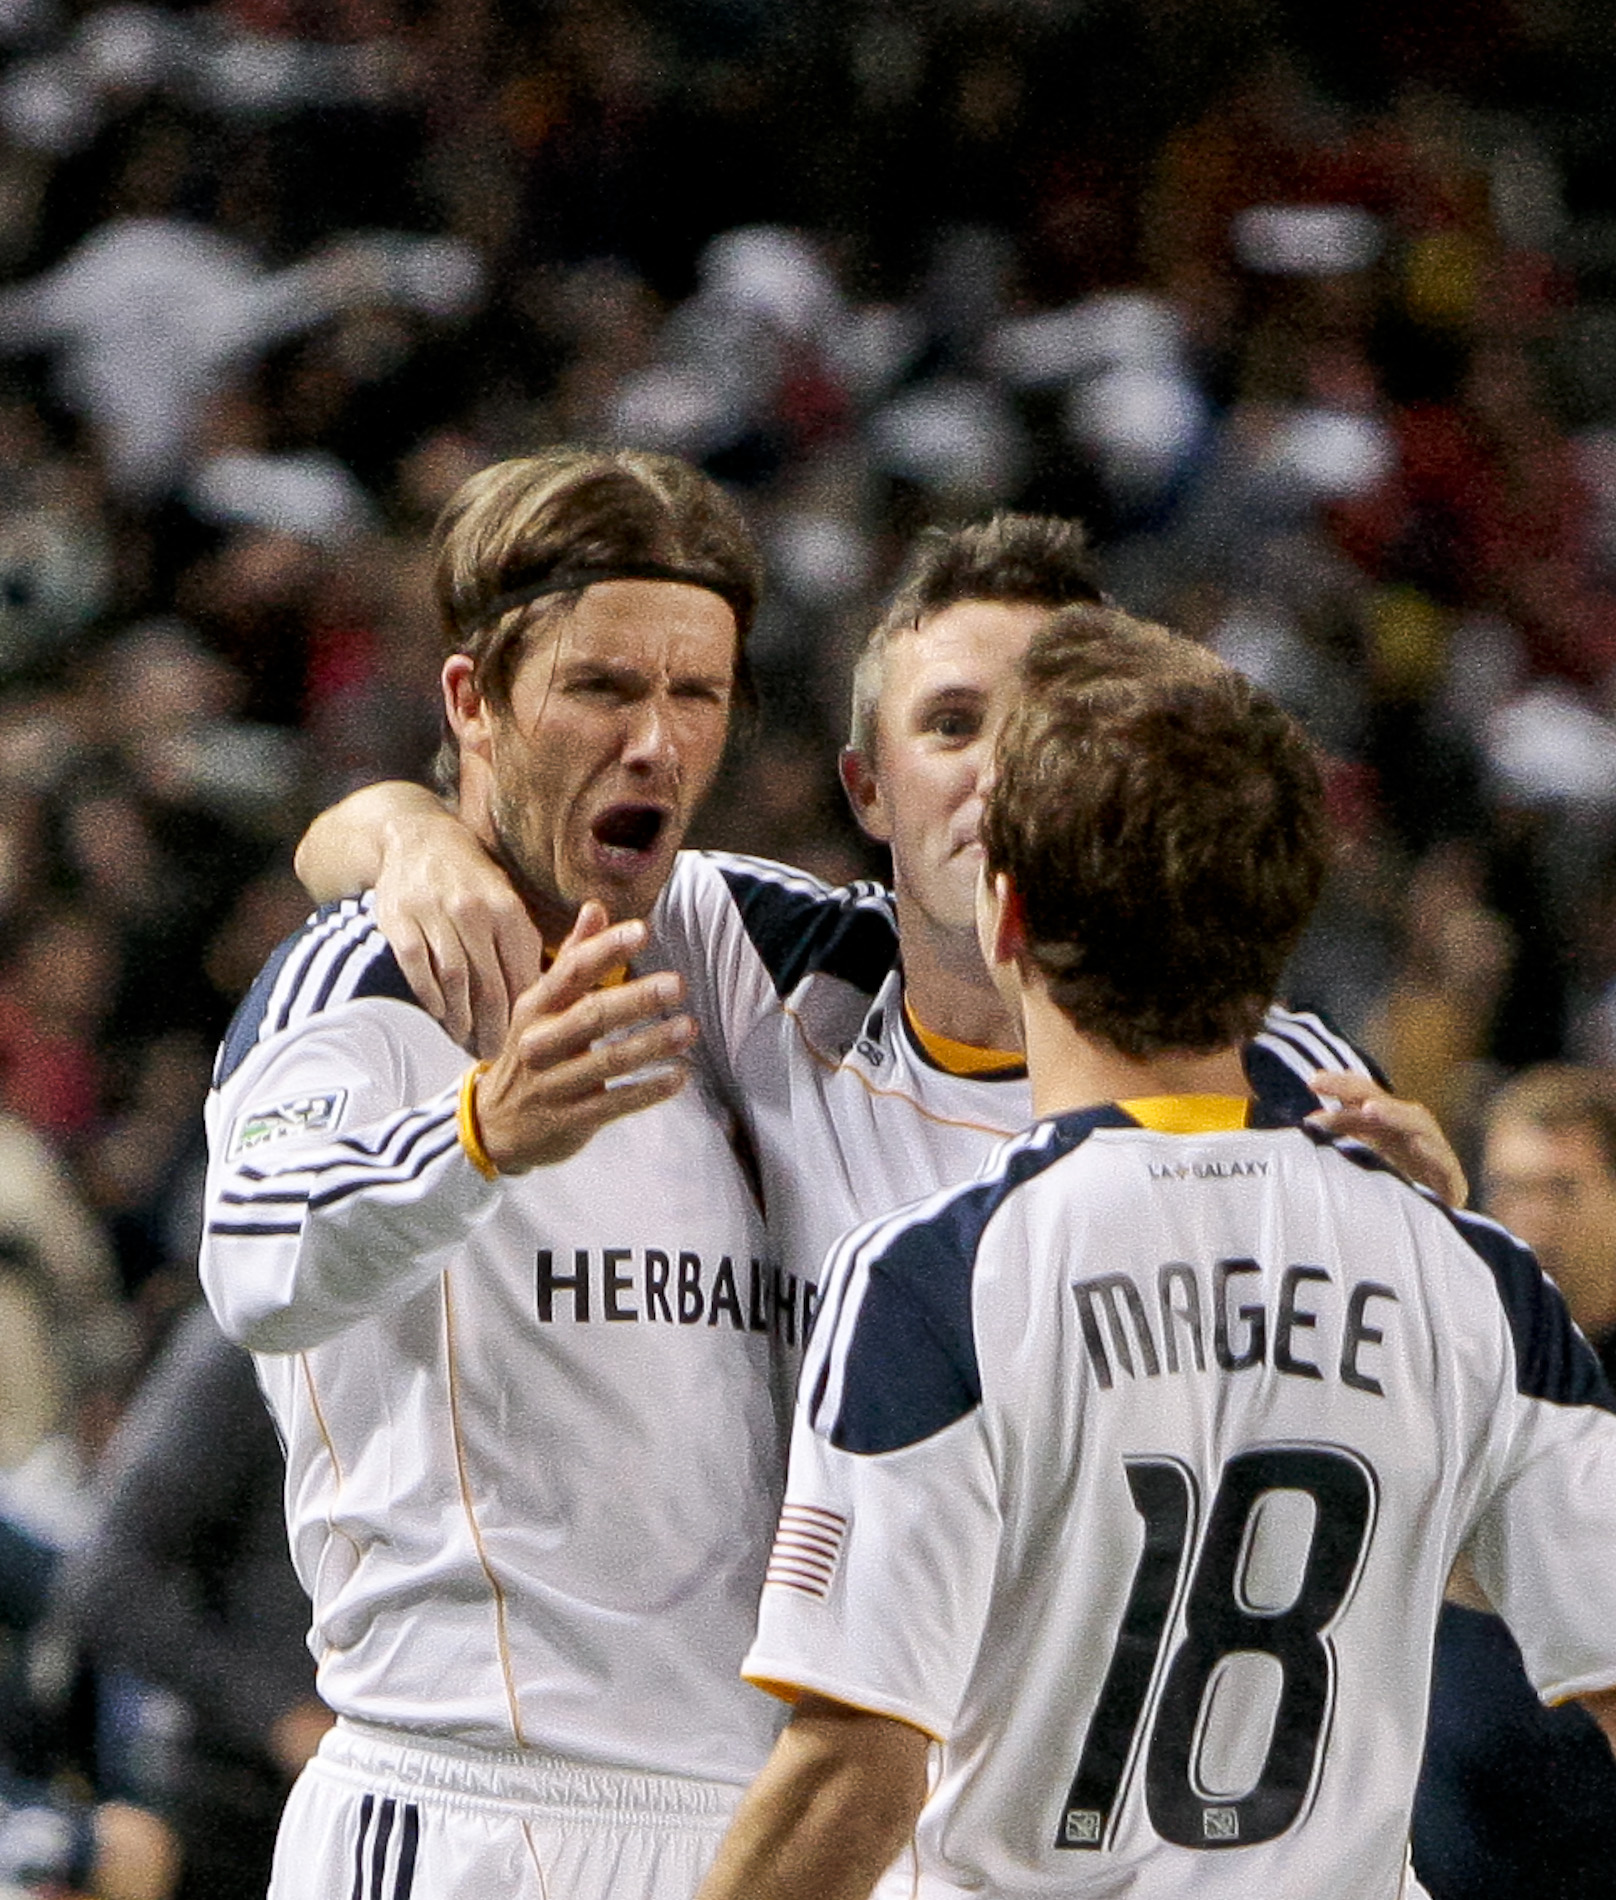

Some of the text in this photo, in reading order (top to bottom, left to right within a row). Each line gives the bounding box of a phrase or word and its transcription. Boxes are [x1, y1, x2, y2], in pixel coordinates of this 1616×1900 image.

[1193, 1160, 1268, 1179] GALAXY
[1072, 1257, 1400, 1398] MAGEE
[1054, 1440, 1381, 1852] 18
